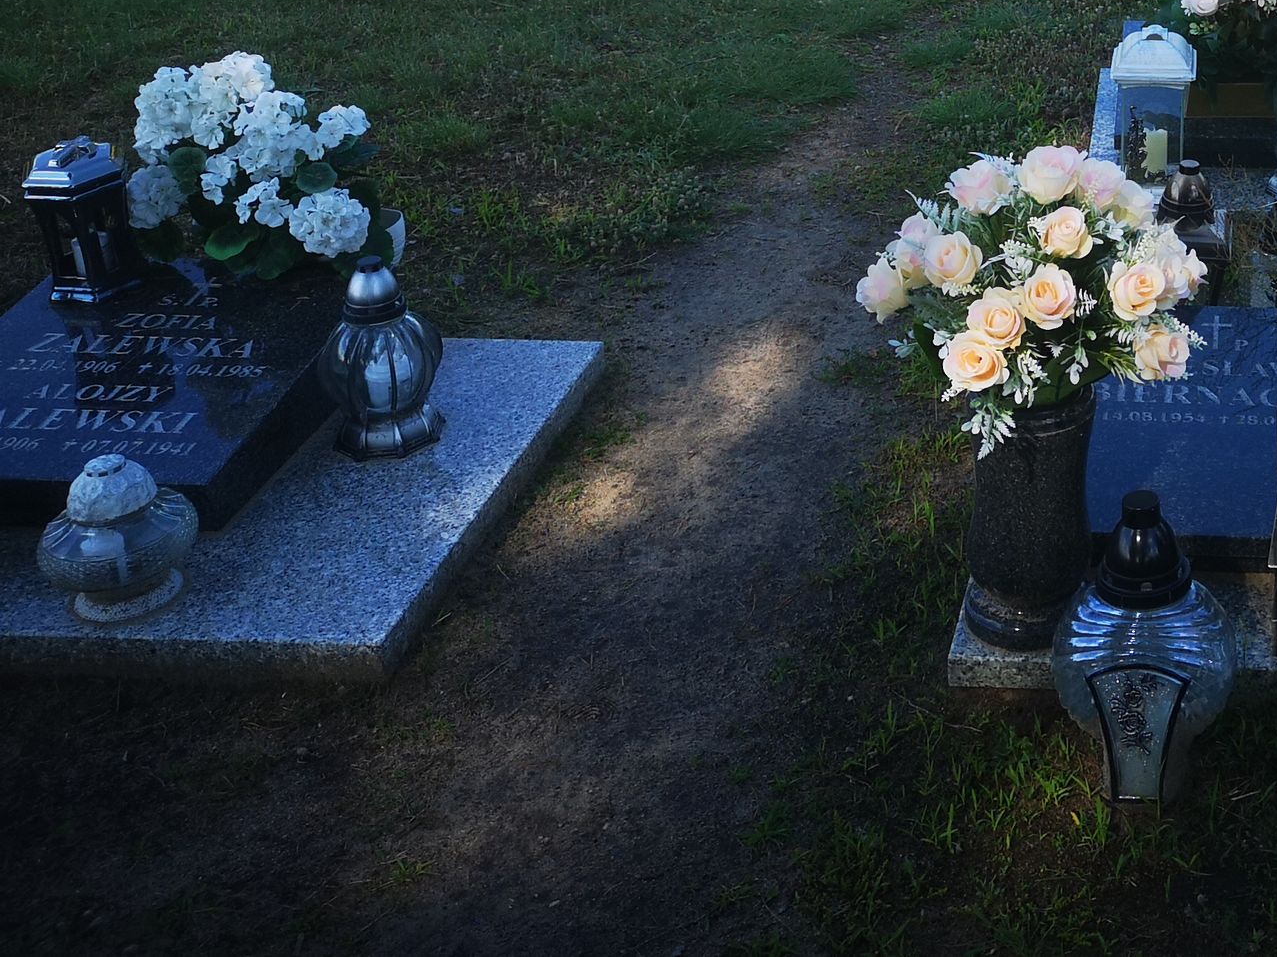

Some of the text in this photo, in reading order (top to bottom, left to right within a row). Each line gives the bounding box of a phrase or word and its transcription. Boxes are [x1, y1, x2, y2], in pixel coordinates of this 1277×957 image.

[115, 313, 217, 330] ZOFIA
[27, 332, 255, 358] ZALEWSKA
[156, 363, 268, 378] 18.04.1985
[23, 383, 175, 403] ALOJZY
[0, 406, 200, 435] LEWSKI
